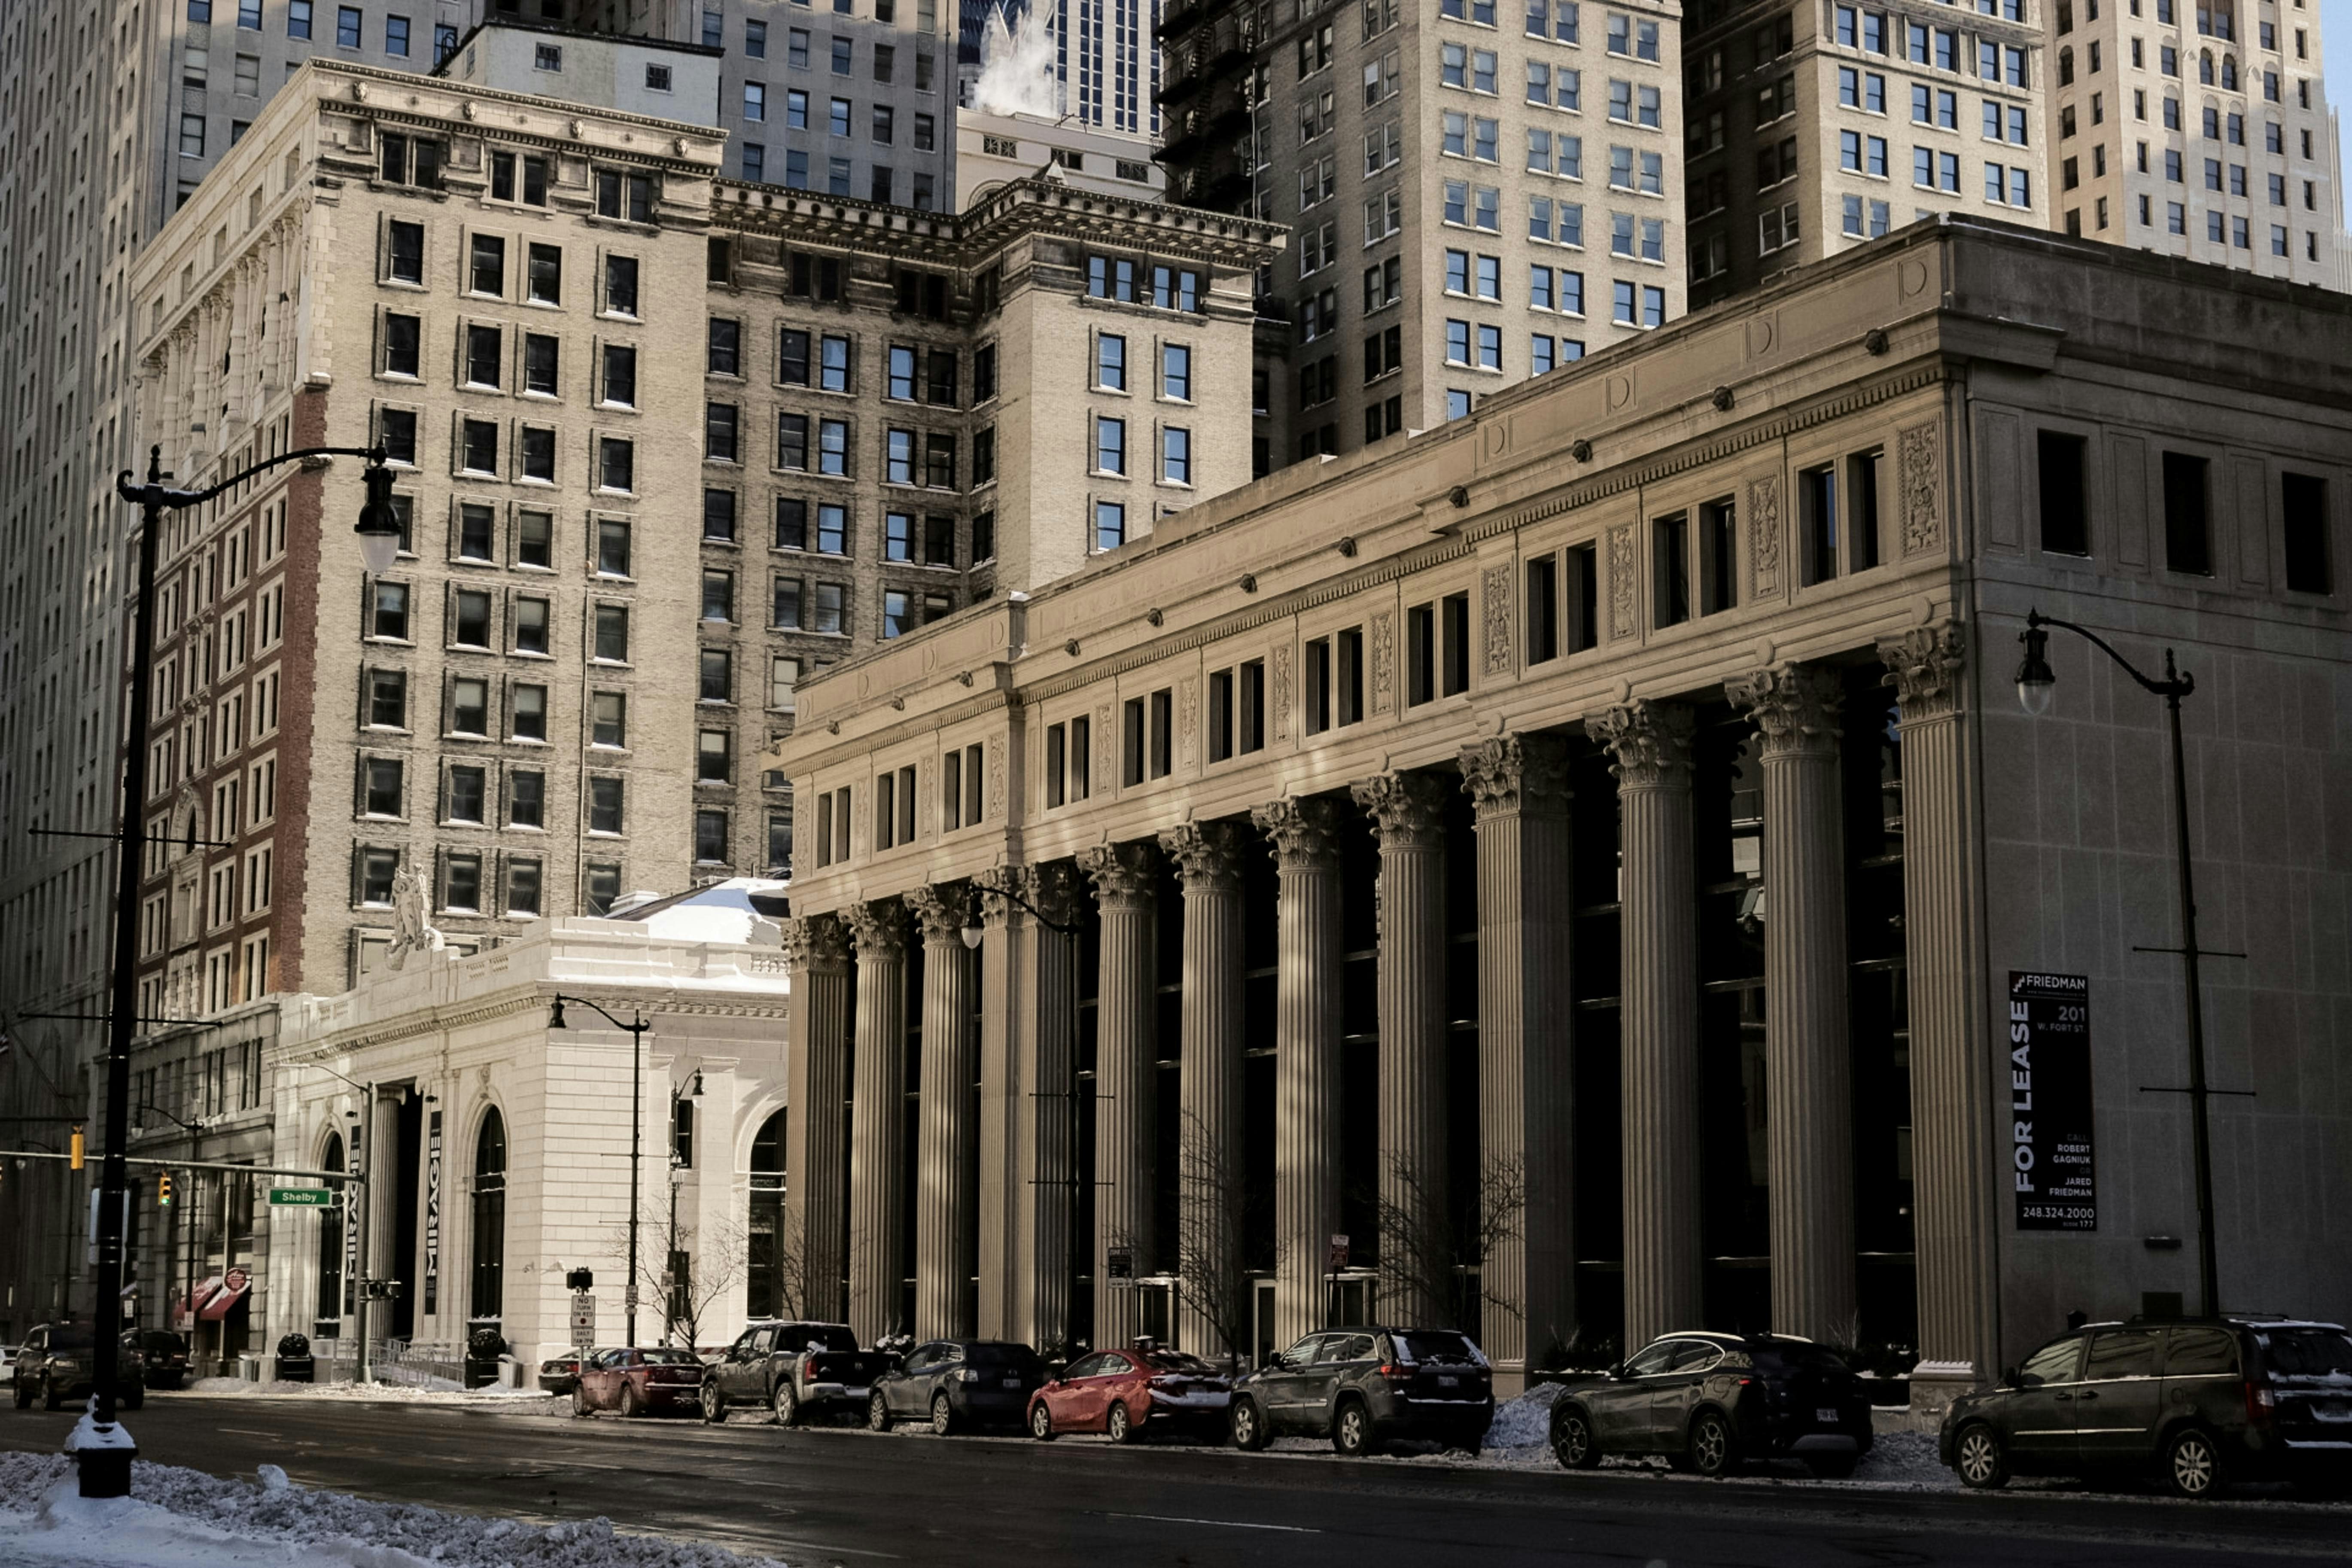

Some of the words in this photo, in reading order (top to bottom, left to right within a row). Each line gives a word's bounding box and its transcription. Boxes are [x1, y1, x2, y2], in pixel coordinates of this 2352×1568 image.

[2026, 975, 2086, 990] FRIEDMAN
[2058, 1005, 2085, 1022] 201
[2037, 1022, 2048, 1031] W.
[2050, 1023, 2072, 1032] FORT
[2010, 1001, 2032, 1111] LEASE
[2057, 1144, 2090, 1153] ROBERT
[2014, 1121, 2035, 1192] FOR
[2052, 1154, 2091, 1164] GAGNIUK
[2065, 1177, 2092, 1186] JARED
[282, 1192, 317, 1203] Shelby
[2049, 1187, 2092, 1197] FRIEDMAN
[427, 1136, 440, 1276] MIRAGE
[2023, 1207, 2094, 1218] 248.324.2000
[2079, 1220, 2093, 1228] 177
